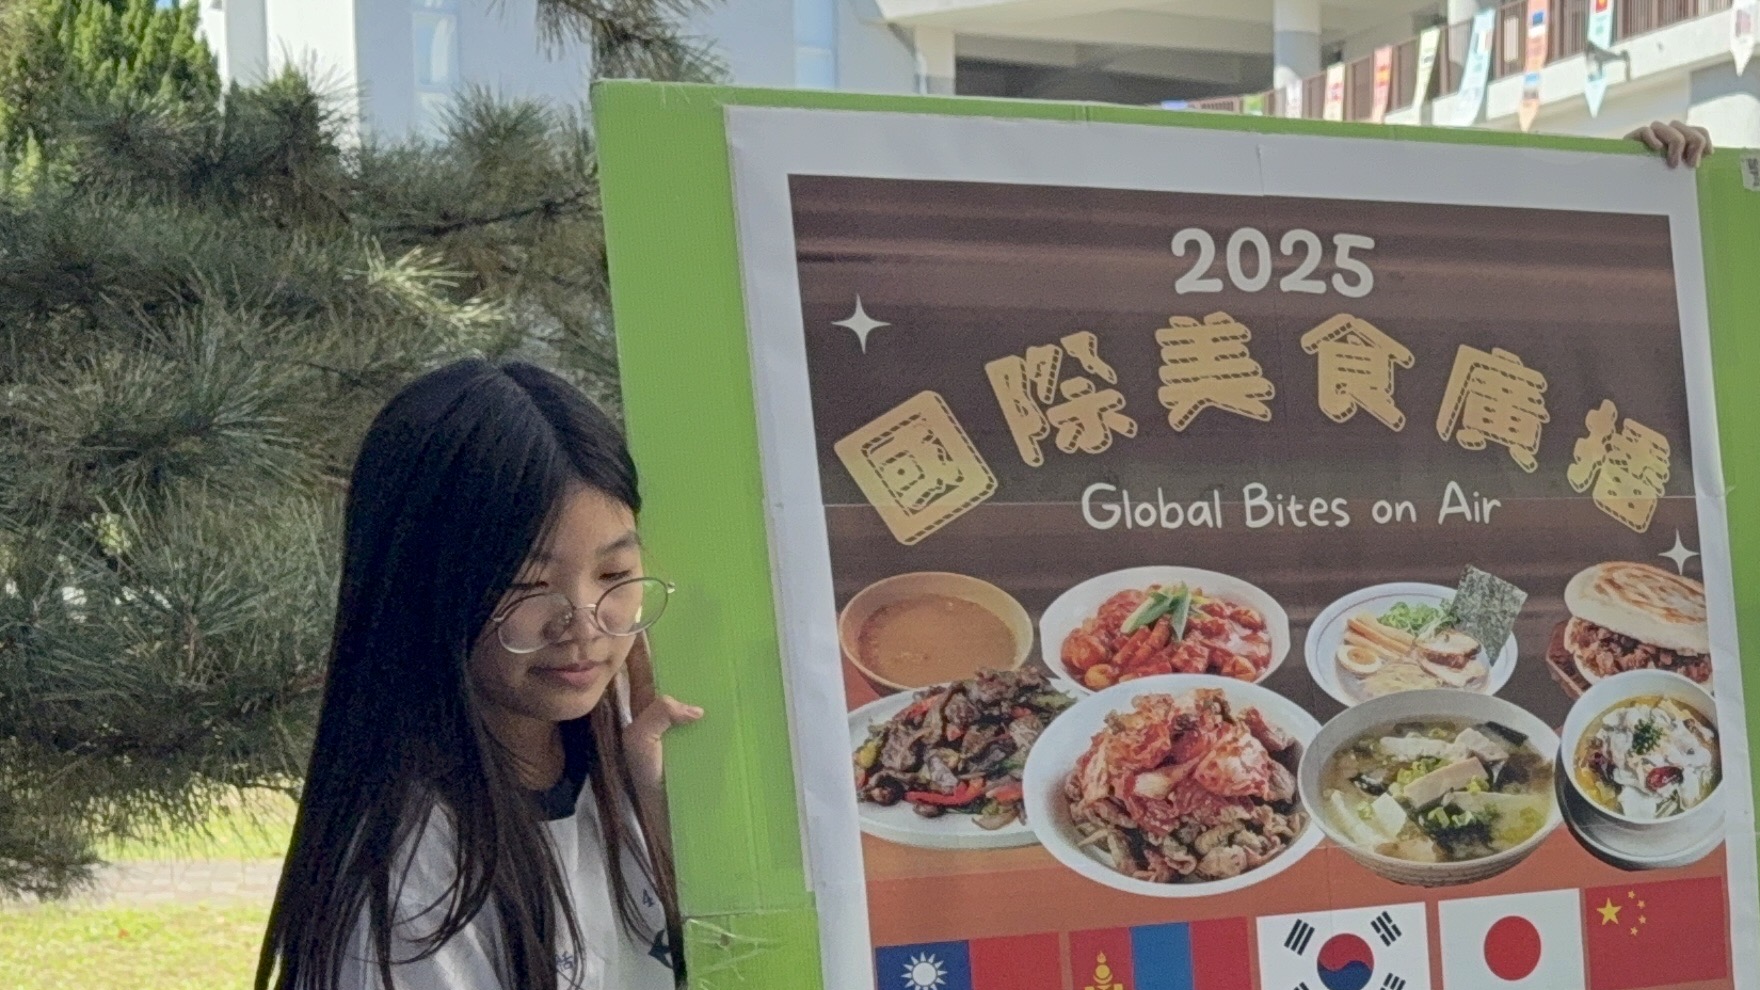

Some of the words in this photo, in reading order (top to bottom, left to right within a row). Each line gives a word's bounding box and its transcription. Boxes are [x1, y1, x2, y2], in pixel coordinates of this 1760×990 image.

[1170, 226, 1376, 299] 2025
[834, 312, 1672, 546] 國際美食廣播
[1081, 481, 1222, 531] Global
[1244, 481, 1350, 529] Bites
[1371, 496, 1418, 527] on
[1438, 479, 1502, 527] Air
